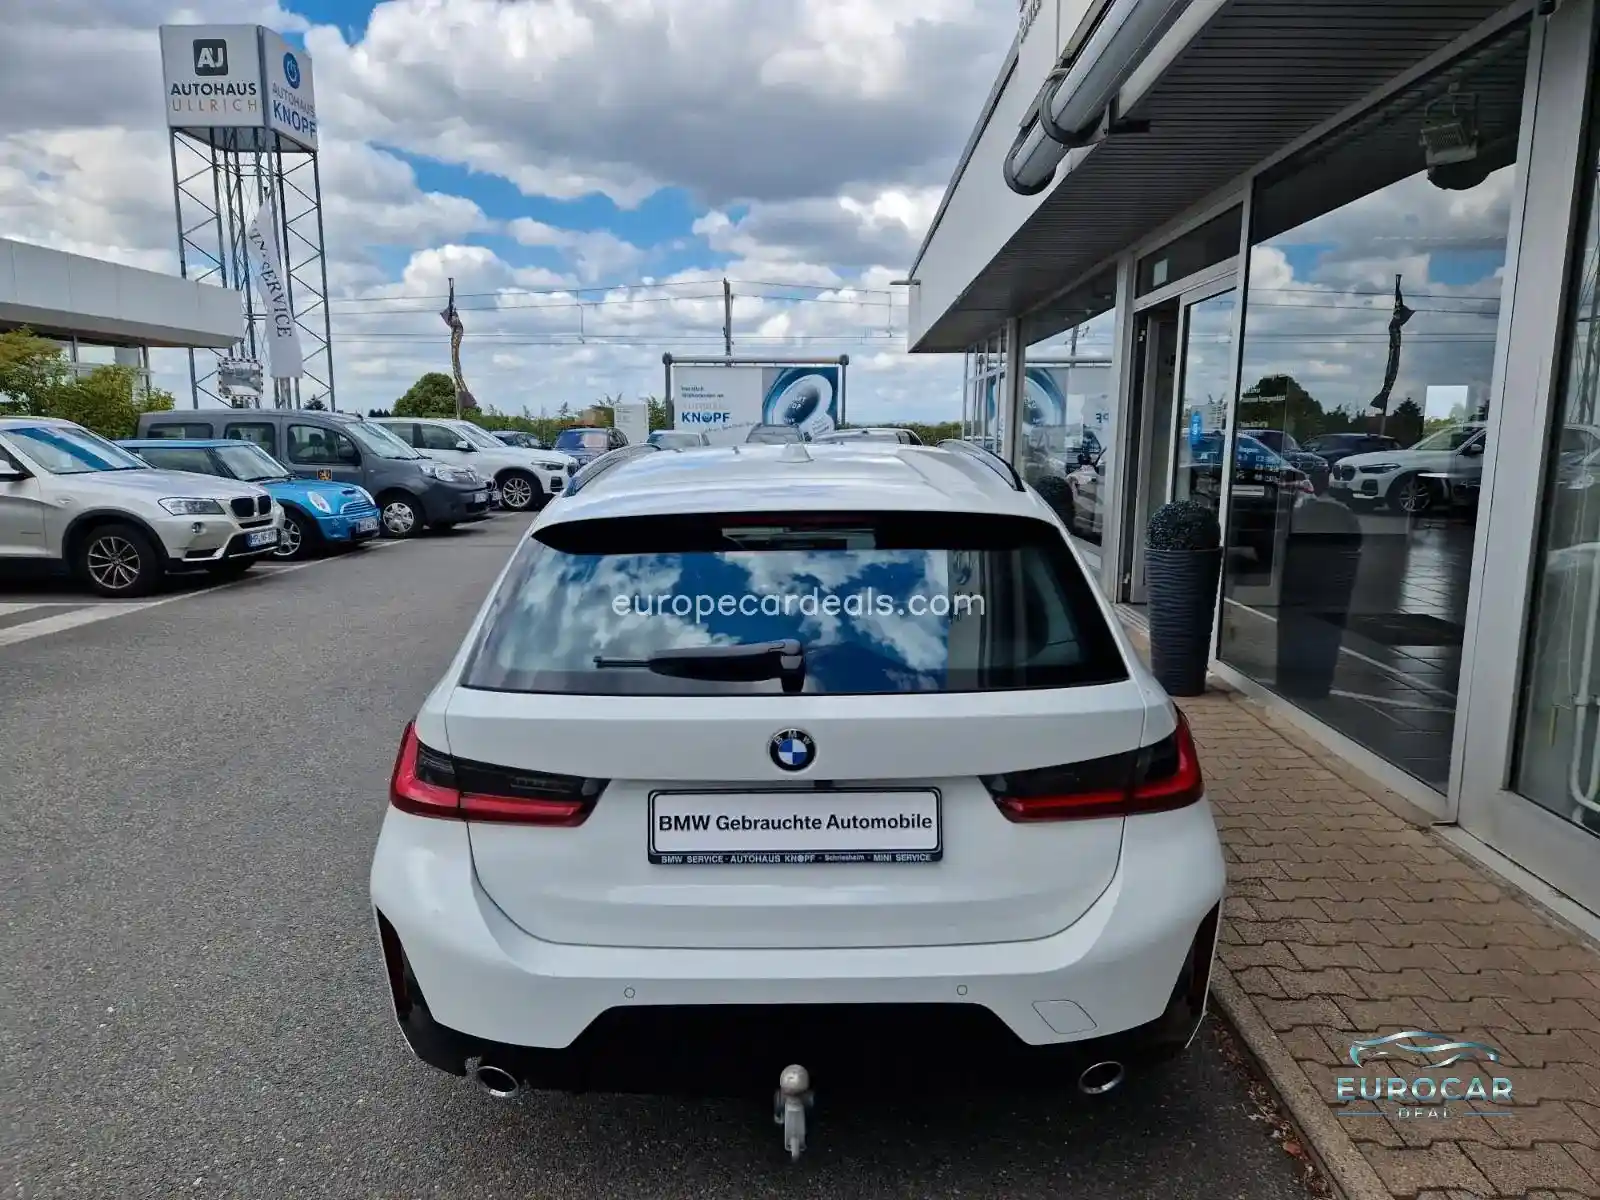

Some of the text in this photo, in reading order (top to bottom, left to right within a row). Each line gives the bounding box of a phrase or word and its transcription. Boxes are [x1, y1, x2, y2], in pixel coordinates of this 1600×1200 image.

[170, 83, 257, 96] AUTOHAUS
[172, 99, 258, 113] ULLRICH
[272, 82, 316, 117] AUTOHAUS
[272, 99, 317, 138] KNOPF
[681, 411, 731, 423] KNOPF
[659, 813, 933, 831] BMW Gebrauchte Automobile
[661, 855, 683, 863] BMW
[687, 855, 723, 863] SERVICE
[730, 854, 781, 863] AUTOHAUS
[785, 853, 815, 862] KNOPF
[873, 853, 892, 862] MINI
[895, 853, 932, 862] SERVICE
